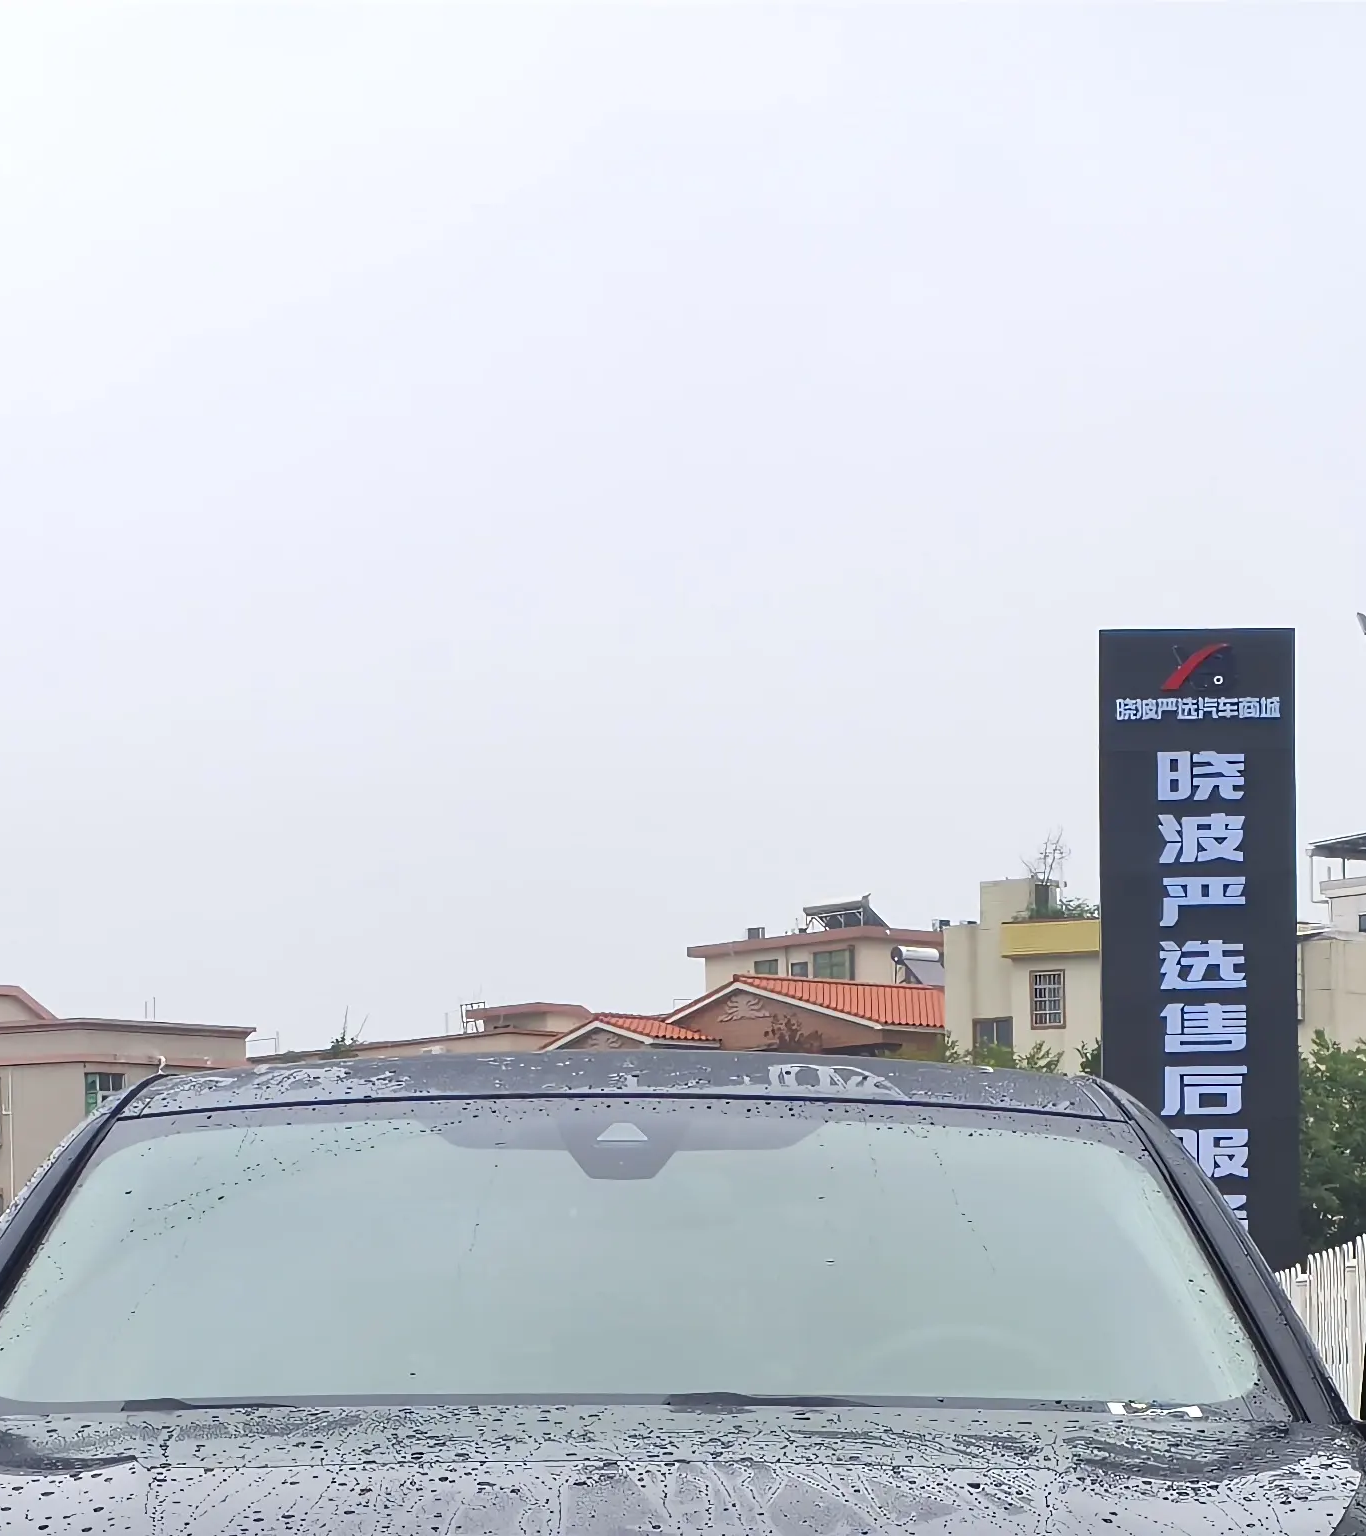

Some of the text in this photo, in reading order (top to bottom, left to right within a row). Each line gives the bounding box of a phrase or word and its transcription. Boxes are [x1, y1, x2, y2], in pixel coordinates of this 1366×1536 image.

[1116, 697, 1281, 720] 晓波严选汽车商城
[1157, 751, 1249, 1231] 晓波严选售后服
